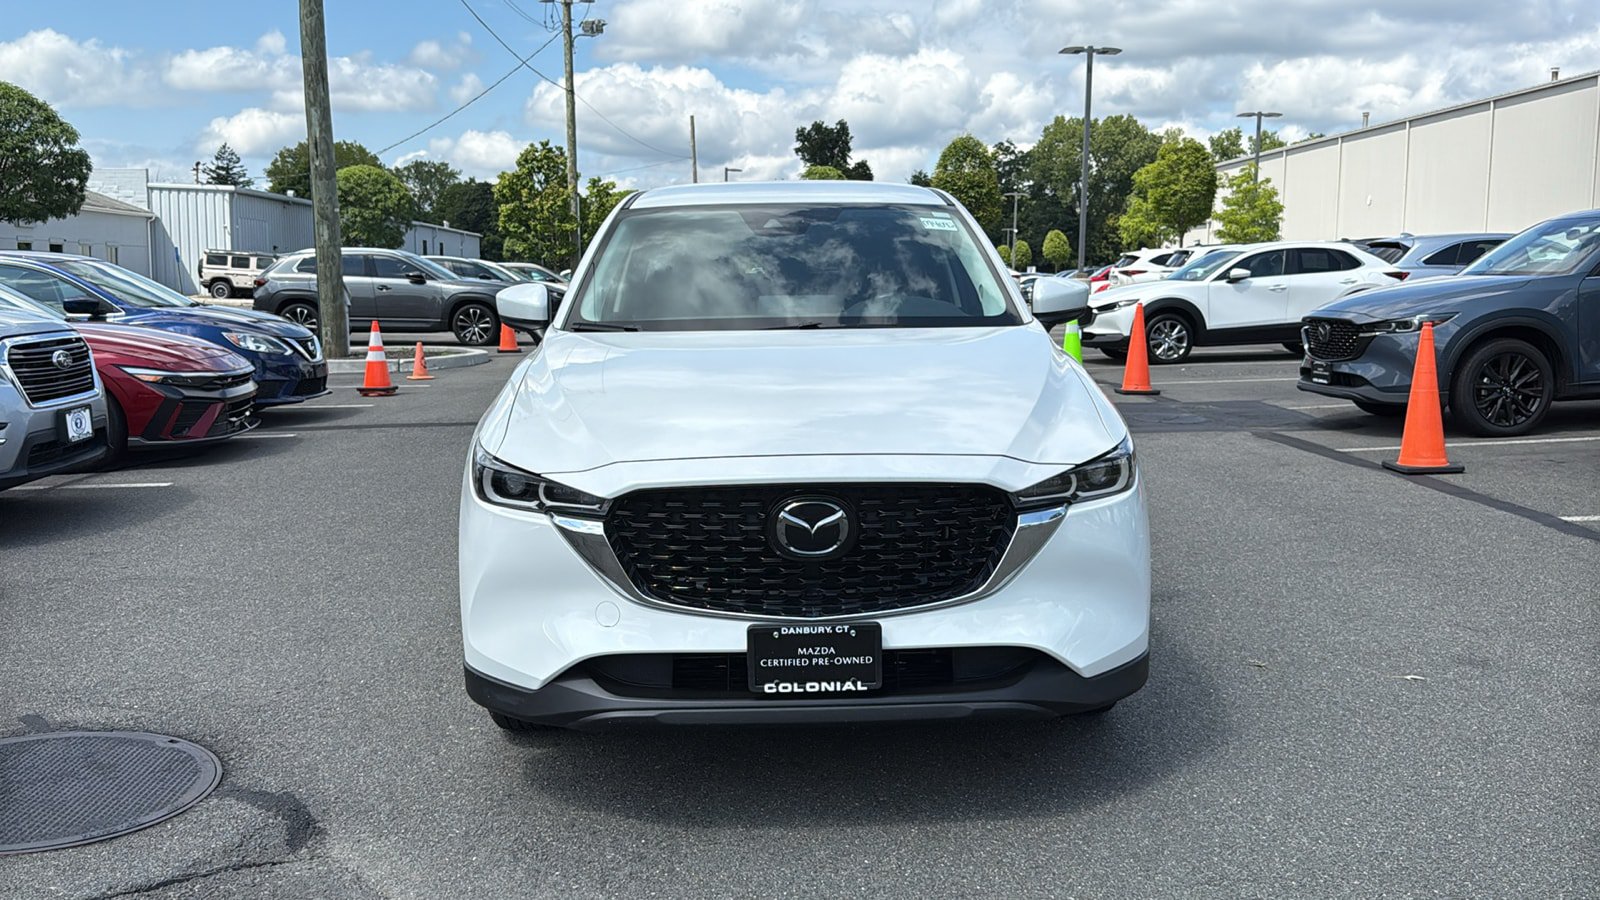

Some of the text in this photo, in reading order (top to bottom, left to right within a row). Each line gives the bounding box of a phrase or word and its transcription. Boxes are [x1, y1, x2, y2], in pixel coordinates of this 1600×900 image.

[835, 625, 850, 633] CT
[797, 646, 836, 655] MAZDA
[760, 656, 873, 667] CERTIFIED PRE-OWNED
[763, 681, 868, 693] COLONIAL
